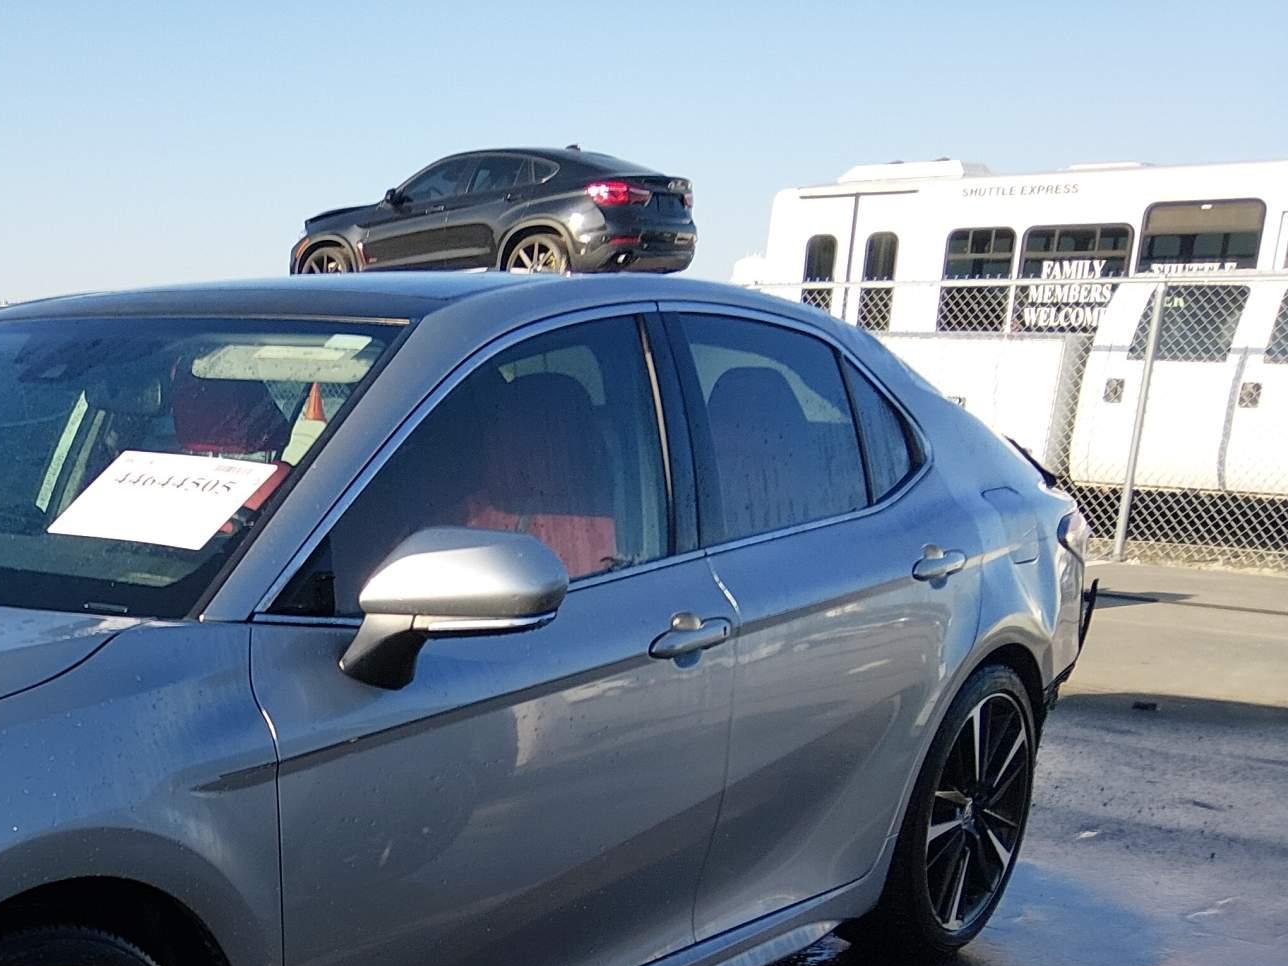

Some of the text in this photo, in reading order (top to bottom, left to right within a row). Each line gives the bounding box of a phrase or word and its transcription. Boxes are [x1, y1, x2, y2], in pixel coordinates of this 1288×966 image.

[962, 184, 1079, 197] SHUTTLE EXPRESS
[1041, 260, 1107, 279] FAMILY
[1028, 284, 1112, 303] MEMBERS
